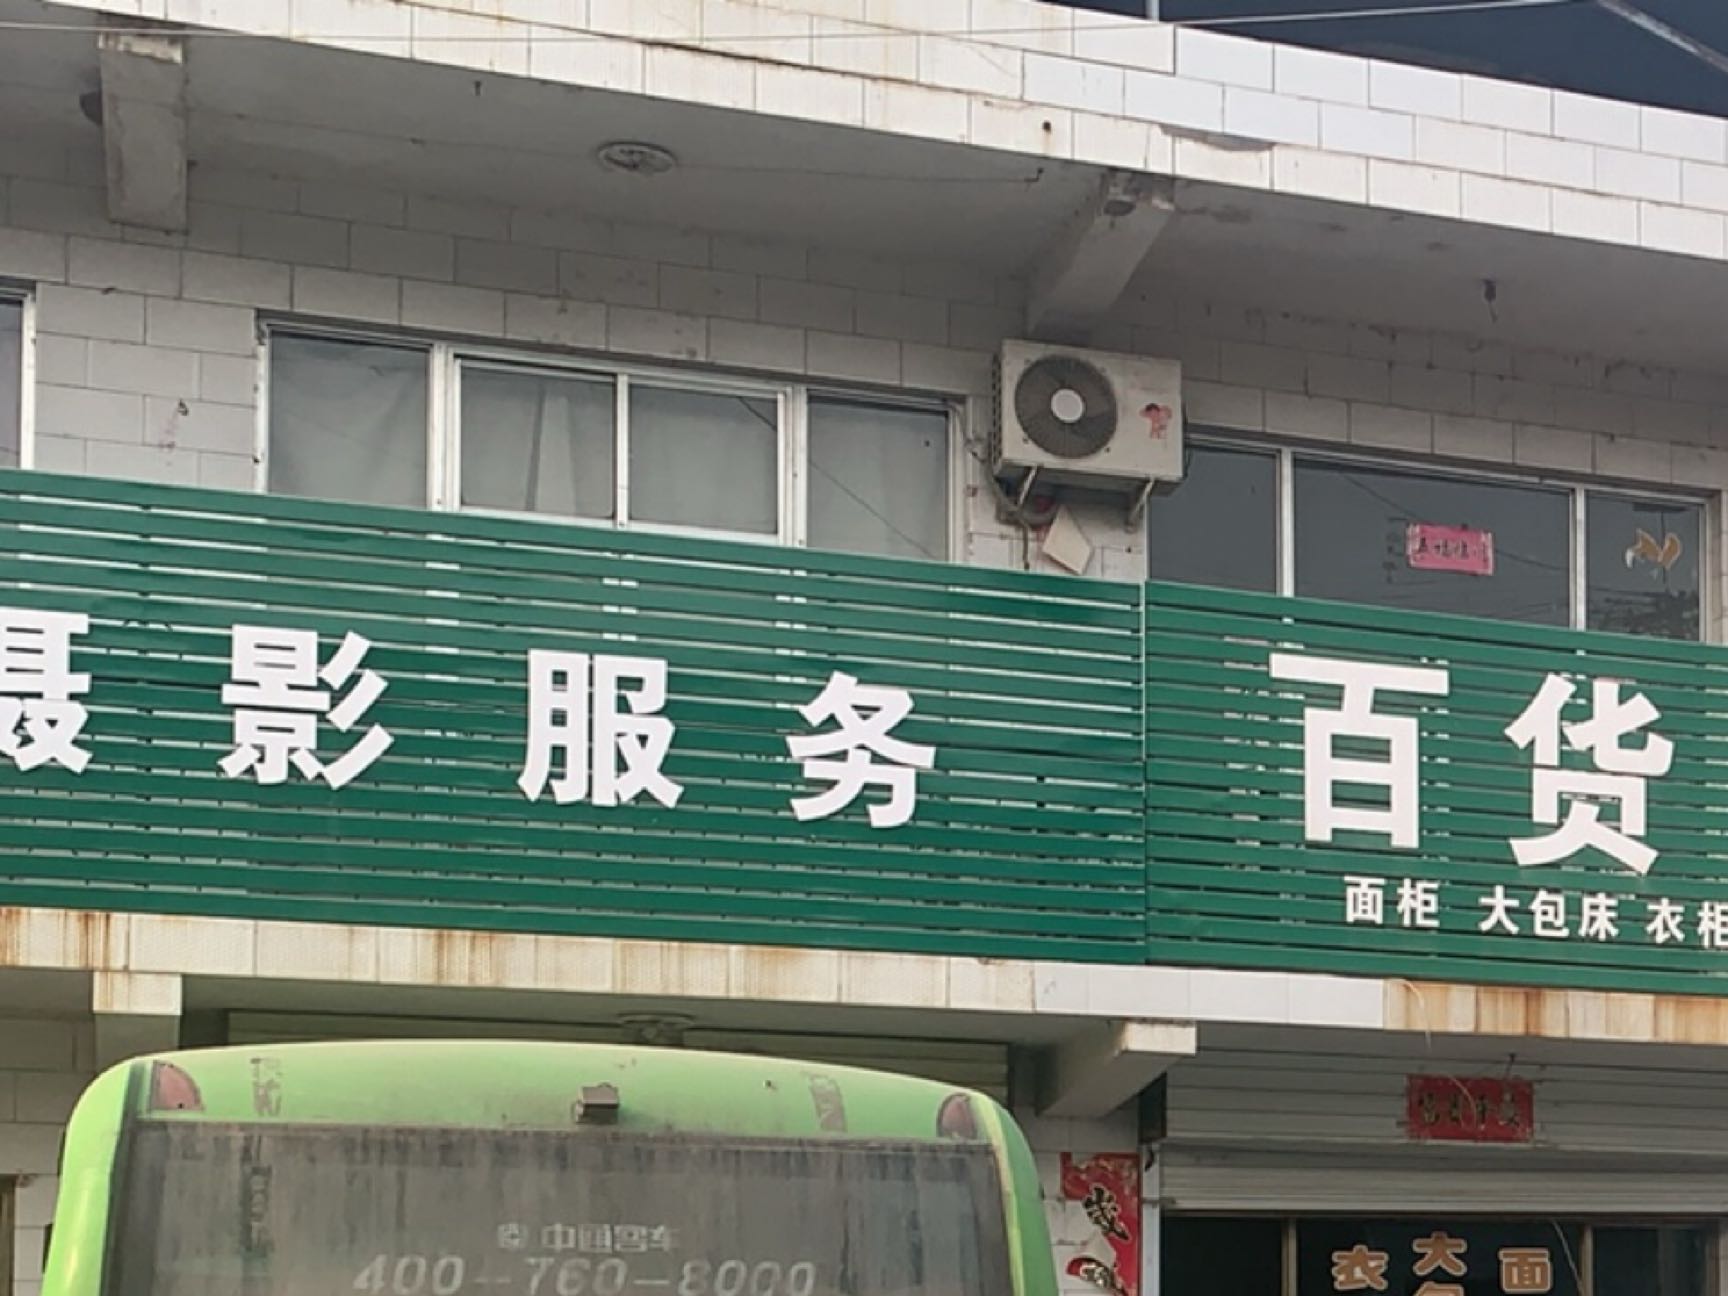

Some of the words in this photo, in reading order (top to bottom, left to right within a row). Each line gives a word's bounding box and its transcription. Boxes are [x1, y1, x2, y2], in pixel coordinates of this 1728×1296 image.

[1344, 875, 1440, 929] 面柜
[1478, 885, 1620, 942] 大包床
